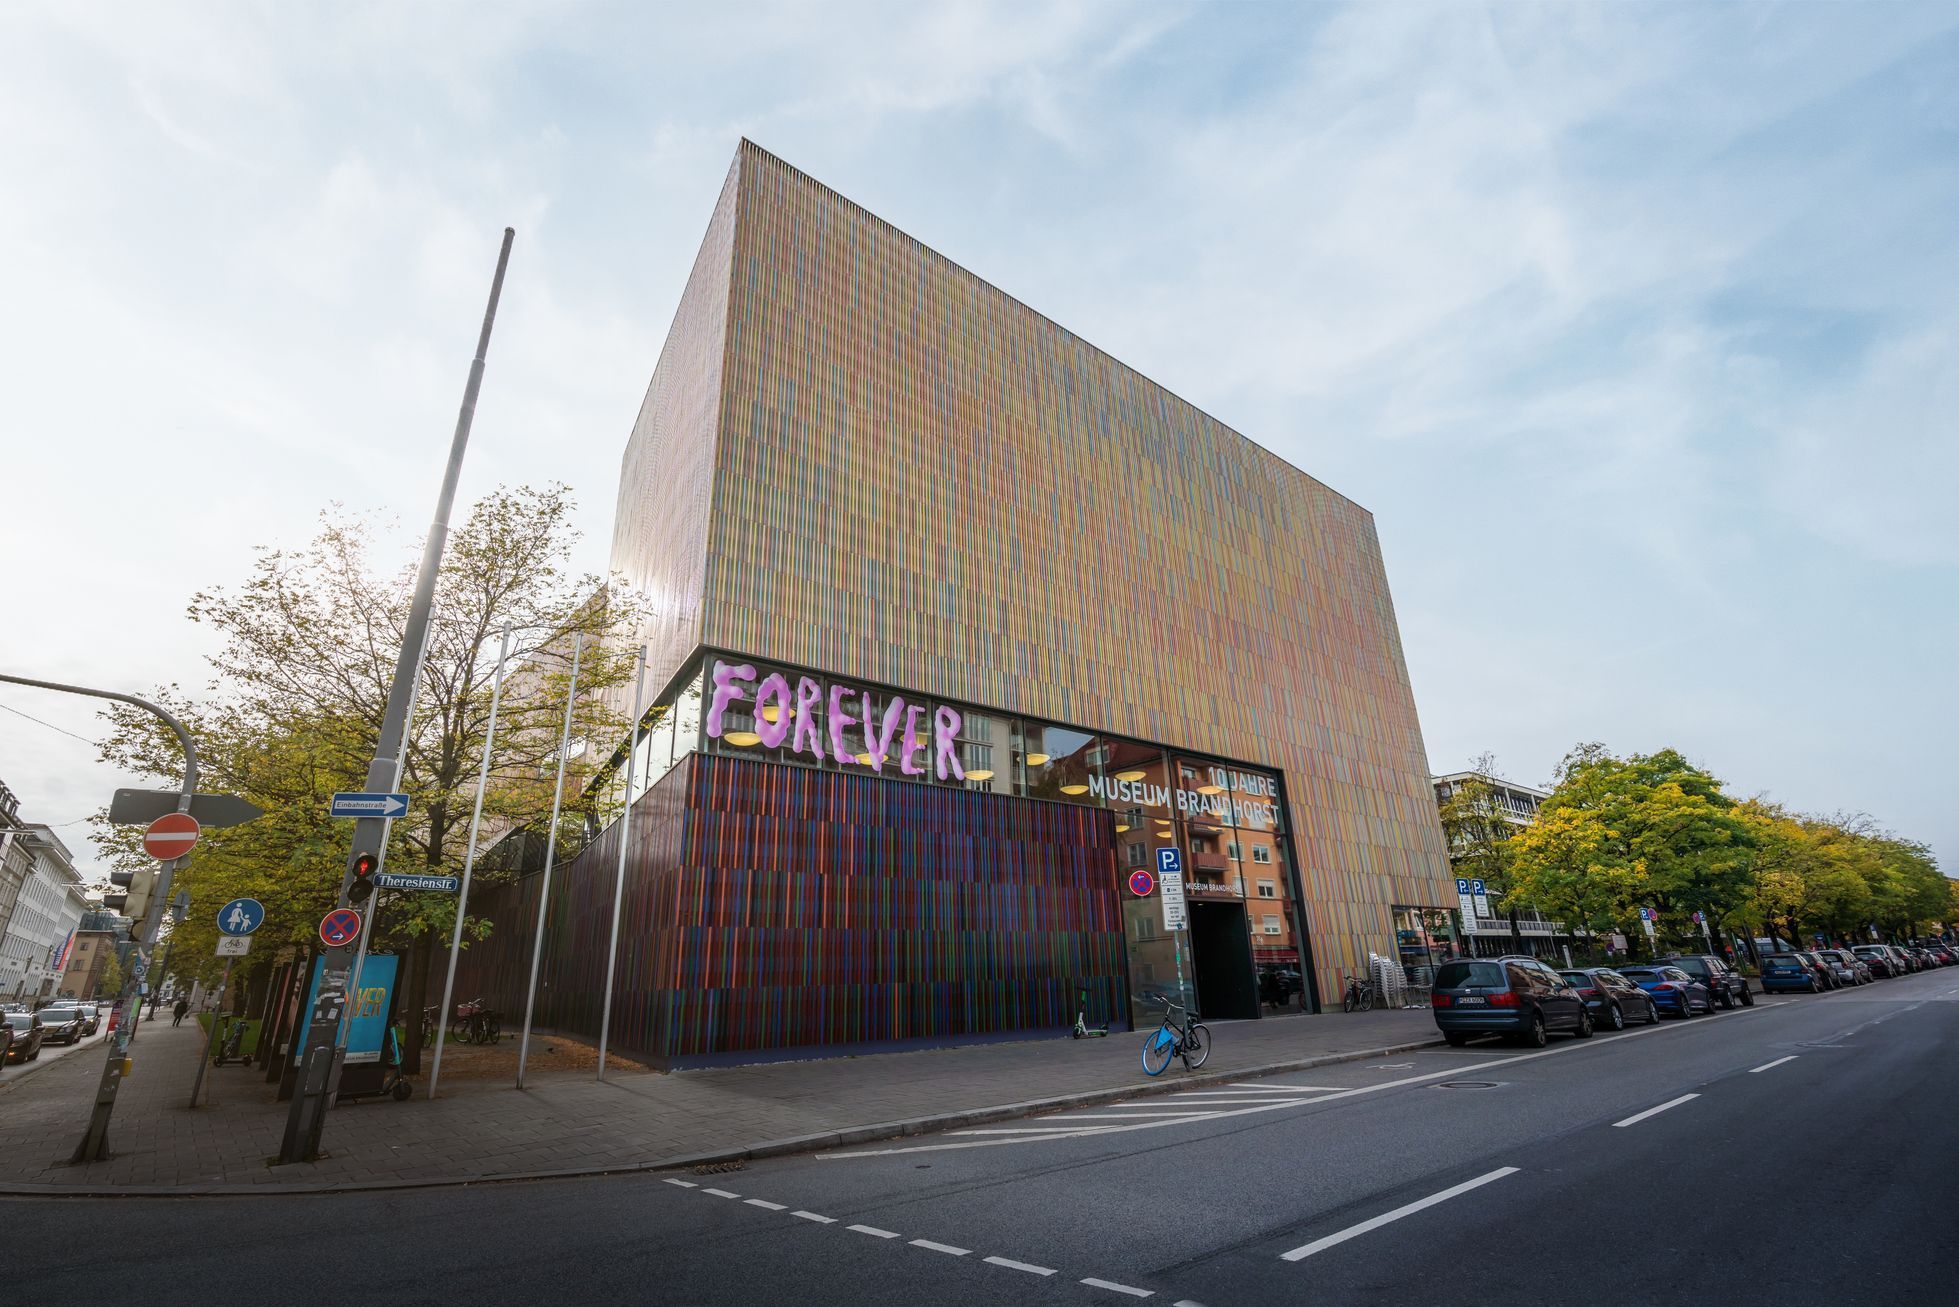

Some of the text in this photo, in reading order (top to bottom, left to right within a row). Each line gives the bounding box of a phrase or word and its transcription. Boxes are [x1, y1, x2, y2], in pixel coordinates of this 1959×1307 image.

[707, 660, 965, 781] FOREVER
[1208, 767, 1277, 798] 10 JAHRE
[336, 801, 387, 809] Einbahnstraße
[1088, 774, 1279, 824] MUSEUM BRANDHORST
[1162, 851, 1175, 870] P
[379, 875, 453, 889] Theresienstr.
[1185, 882, 1209, 891] MUSEUM
[1209, 883, 1241, 892] BRANDHOR
[1459, 880, 1467, 893] P
[1474, 881, 1481, 894] P
